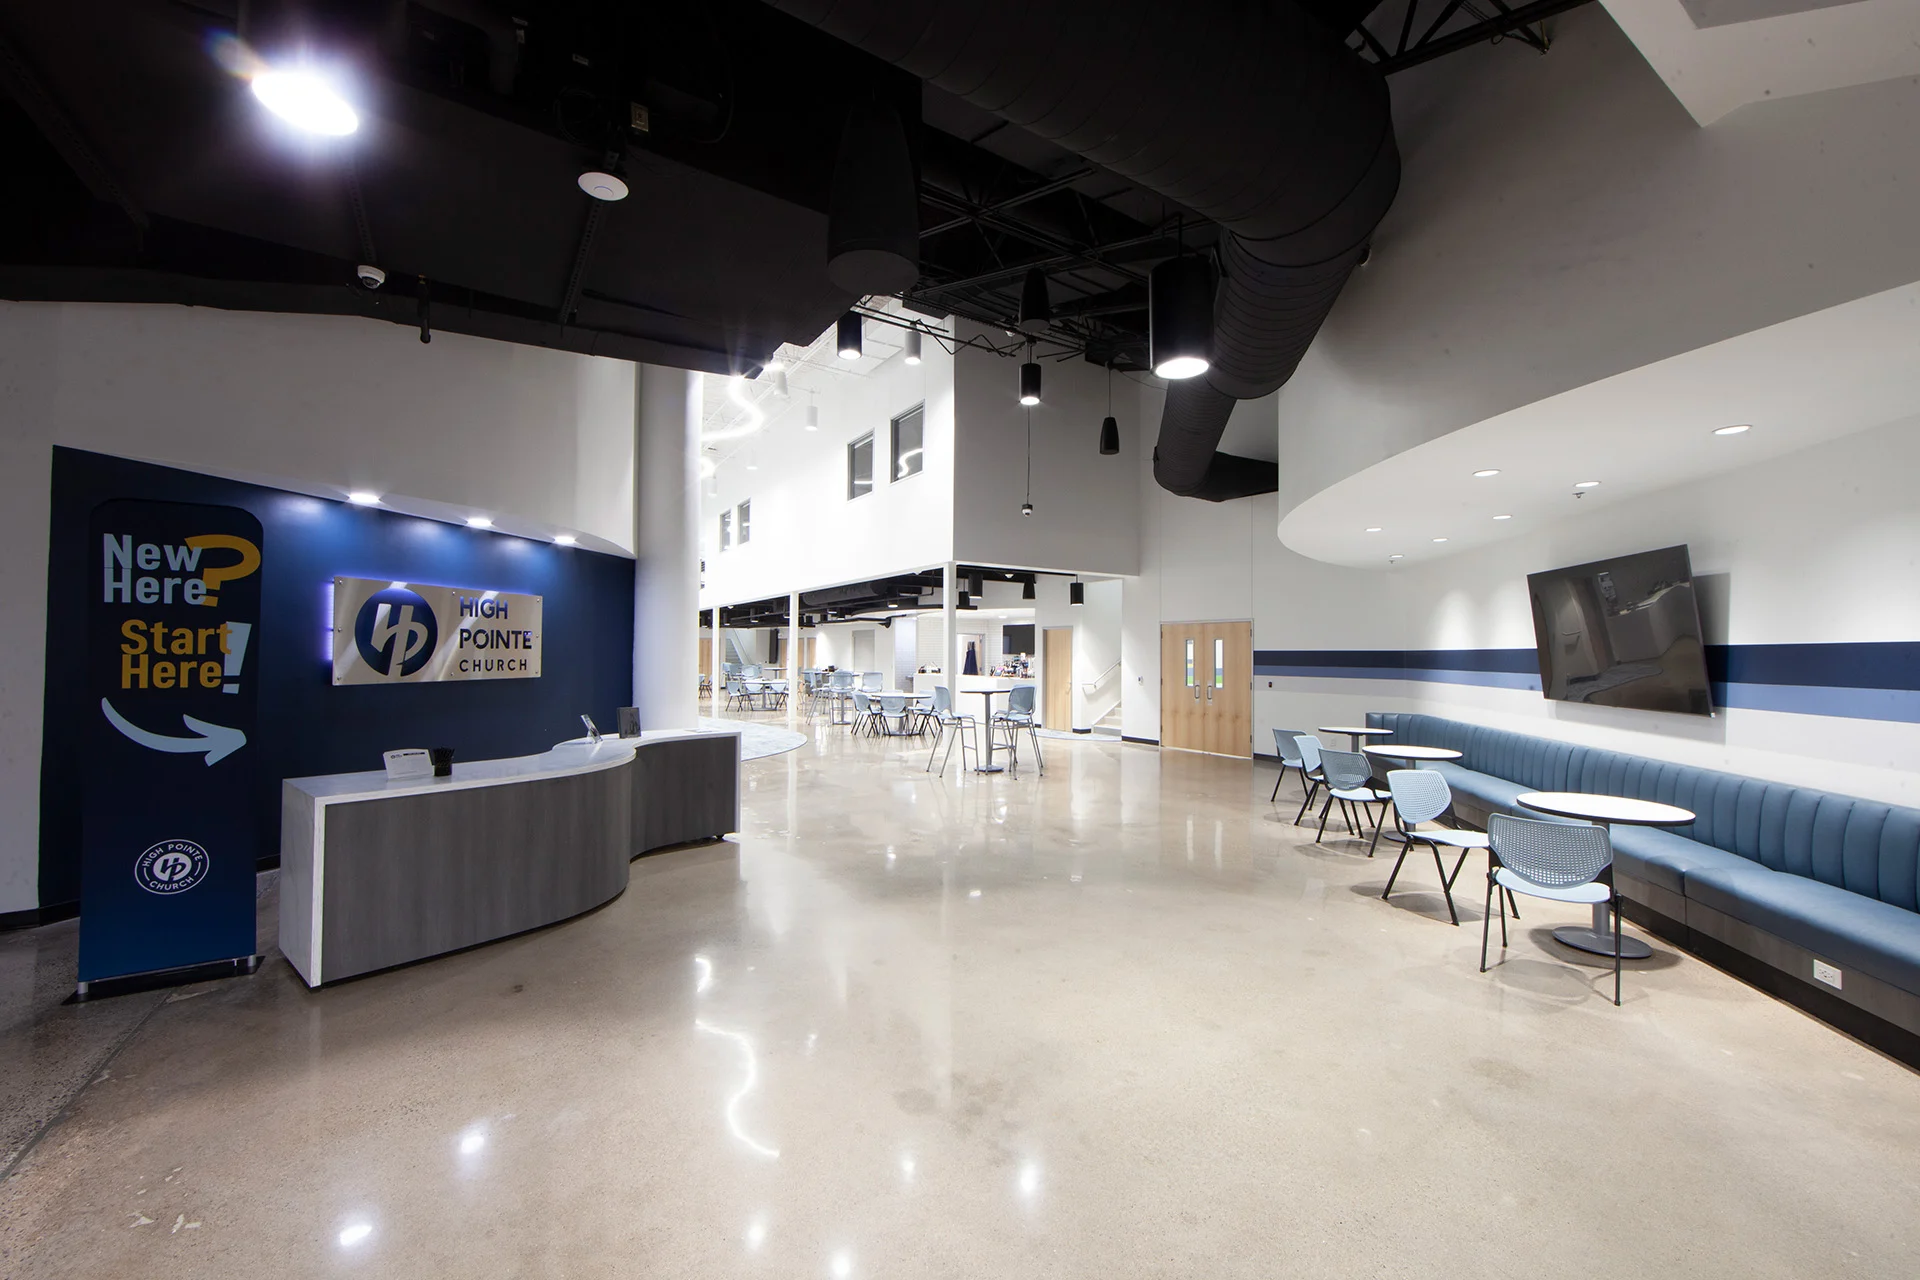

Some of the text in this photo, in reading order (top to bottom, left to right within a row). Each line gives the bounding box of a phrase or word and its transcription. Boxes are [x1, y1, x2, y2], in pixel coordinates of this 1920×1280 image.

[103, 533, 203, 572] New
[459, 597, 508, 619] HIGH
[120, 619, 233, 655] Start
[459, 629, 532, 649] POINTE
[459, 659, 527, 672] CHURCH
[142, 843, 203, 867] HIGH POINTE
[149, 876, 194, 891] CHURCH
